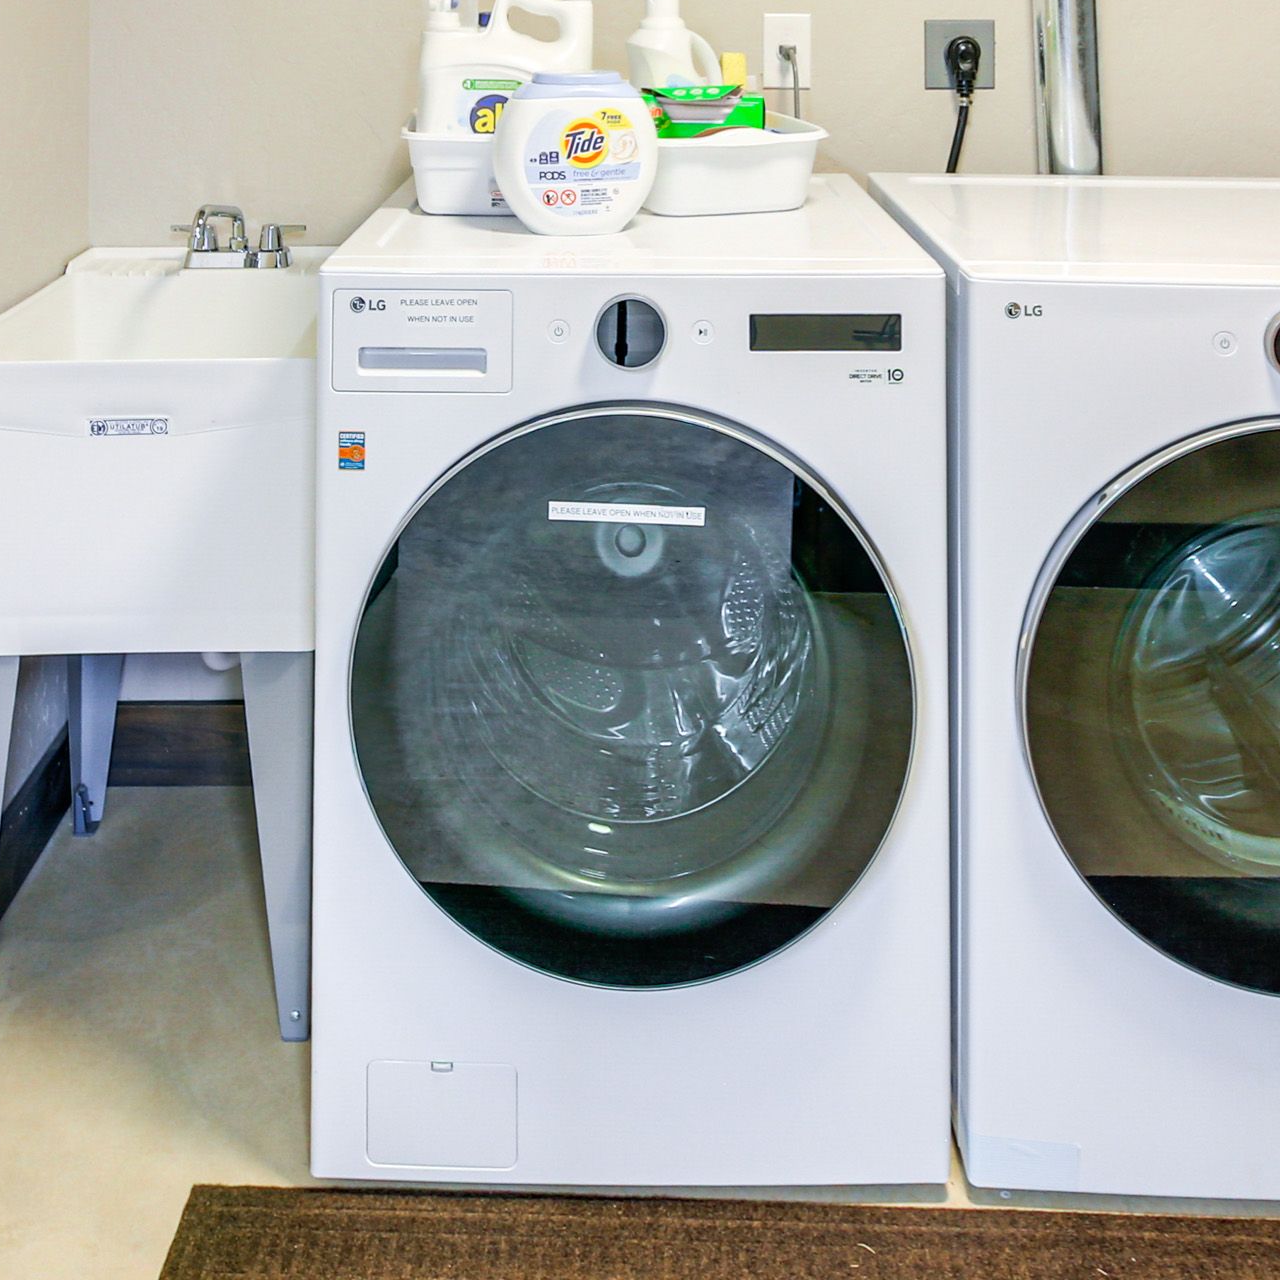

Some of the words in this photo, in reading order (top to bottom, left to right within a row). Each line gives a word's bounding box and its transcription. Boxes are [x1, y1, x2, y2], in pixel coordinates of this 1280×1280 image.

[474, 102, 504, 133] al
[565, 130, 605, 160] Tide
[539, 171, 566, 180] PODS
[369, 299, 386, 311] LG
[1024, 305, 1043, 317] LG
[552, 507, 581, 515] PLEASE
[582, 508, 608, 516] LEAVE
[610, 508, 631, 517] OPEN
[633, 510, 656, 518] WHEN
[687, 511, 702, 520] USE
